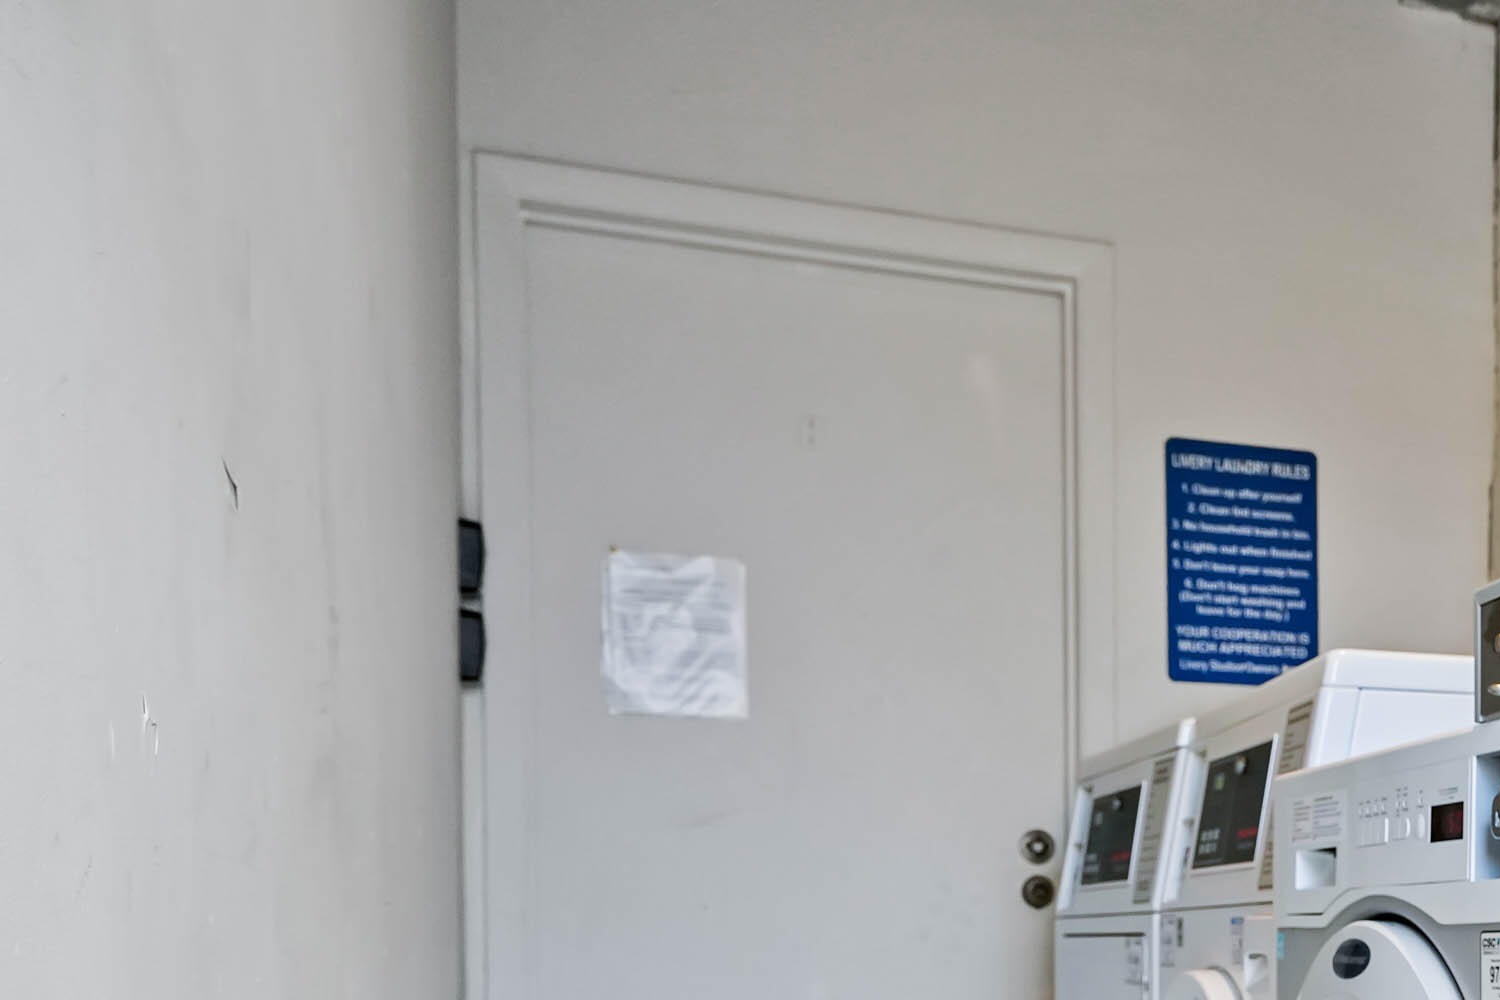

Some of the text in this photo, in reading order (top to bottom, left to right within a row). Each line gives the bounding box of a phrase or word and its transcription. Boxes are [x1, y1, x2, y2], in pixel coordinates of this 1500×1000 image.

[1171, 453, 1311, 480] LIVERY LAUNDRY RULES
[1191, 483, 1221, 496] Clean
[1199, 503, 1229, 516] Clean
[1176, 624, 1210, 638] YOUR
[1211, 626, 1297, 643] COOPERATION
[1178, 639, 1308, 659] MUCH APPRECIATED
